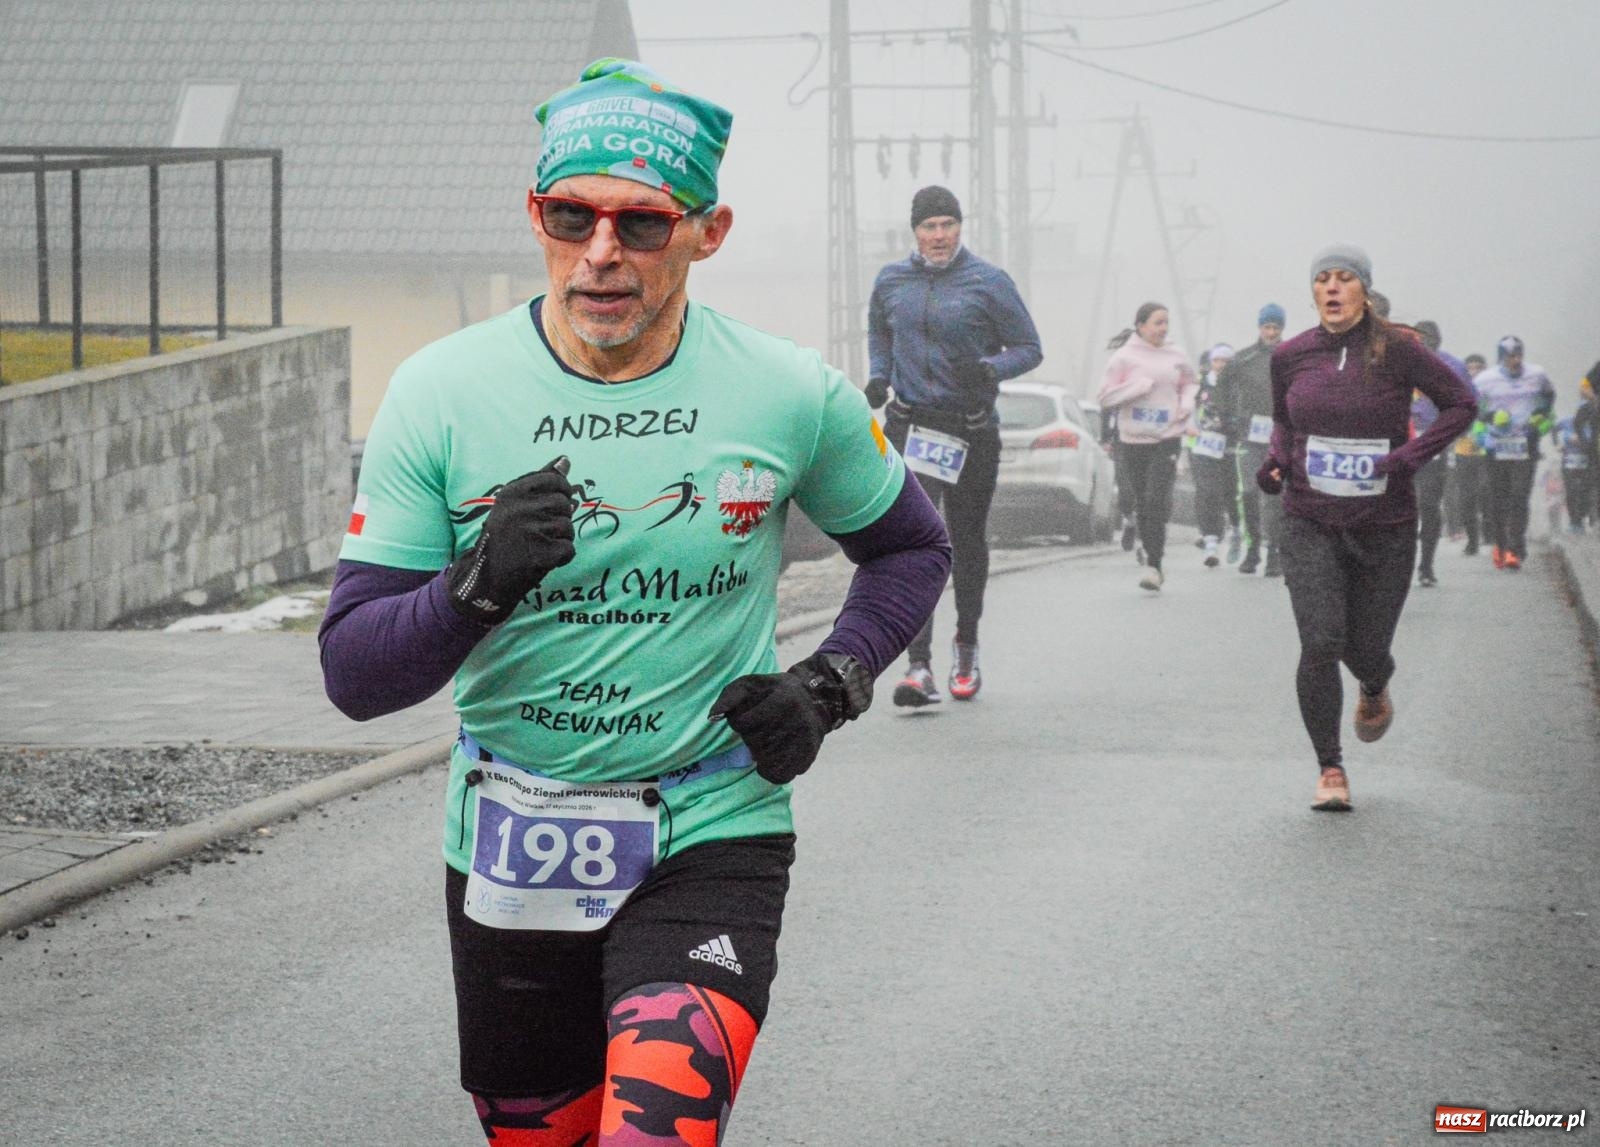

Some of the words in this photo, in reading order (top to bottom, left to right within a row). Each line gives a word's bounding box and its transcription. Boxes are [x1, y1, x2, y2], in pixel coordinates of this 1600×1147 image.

[603, 133, 688, 174] GÓRA
[533, 408, 698, 443] ANDRZEJ
[917, 441, 954, 467] 145
[1322, 453, 1375, 480] 140
[621, 560, 748, 602] Malibu
[558, 609, 671, 625] Racibórz
[559, 681, 631, 704] TEAM
[519, 702, 664, 736] DREWNIAK
[494, 772, 508, 784] Eko
[521, 786, 531, 795] po
[532, 787, 564, 799] Ziemi
[566, 789, 641, 801] Pietrowickiej
[490, 815, 617, 886] 198
[688, 949, 743, 975] adidas
